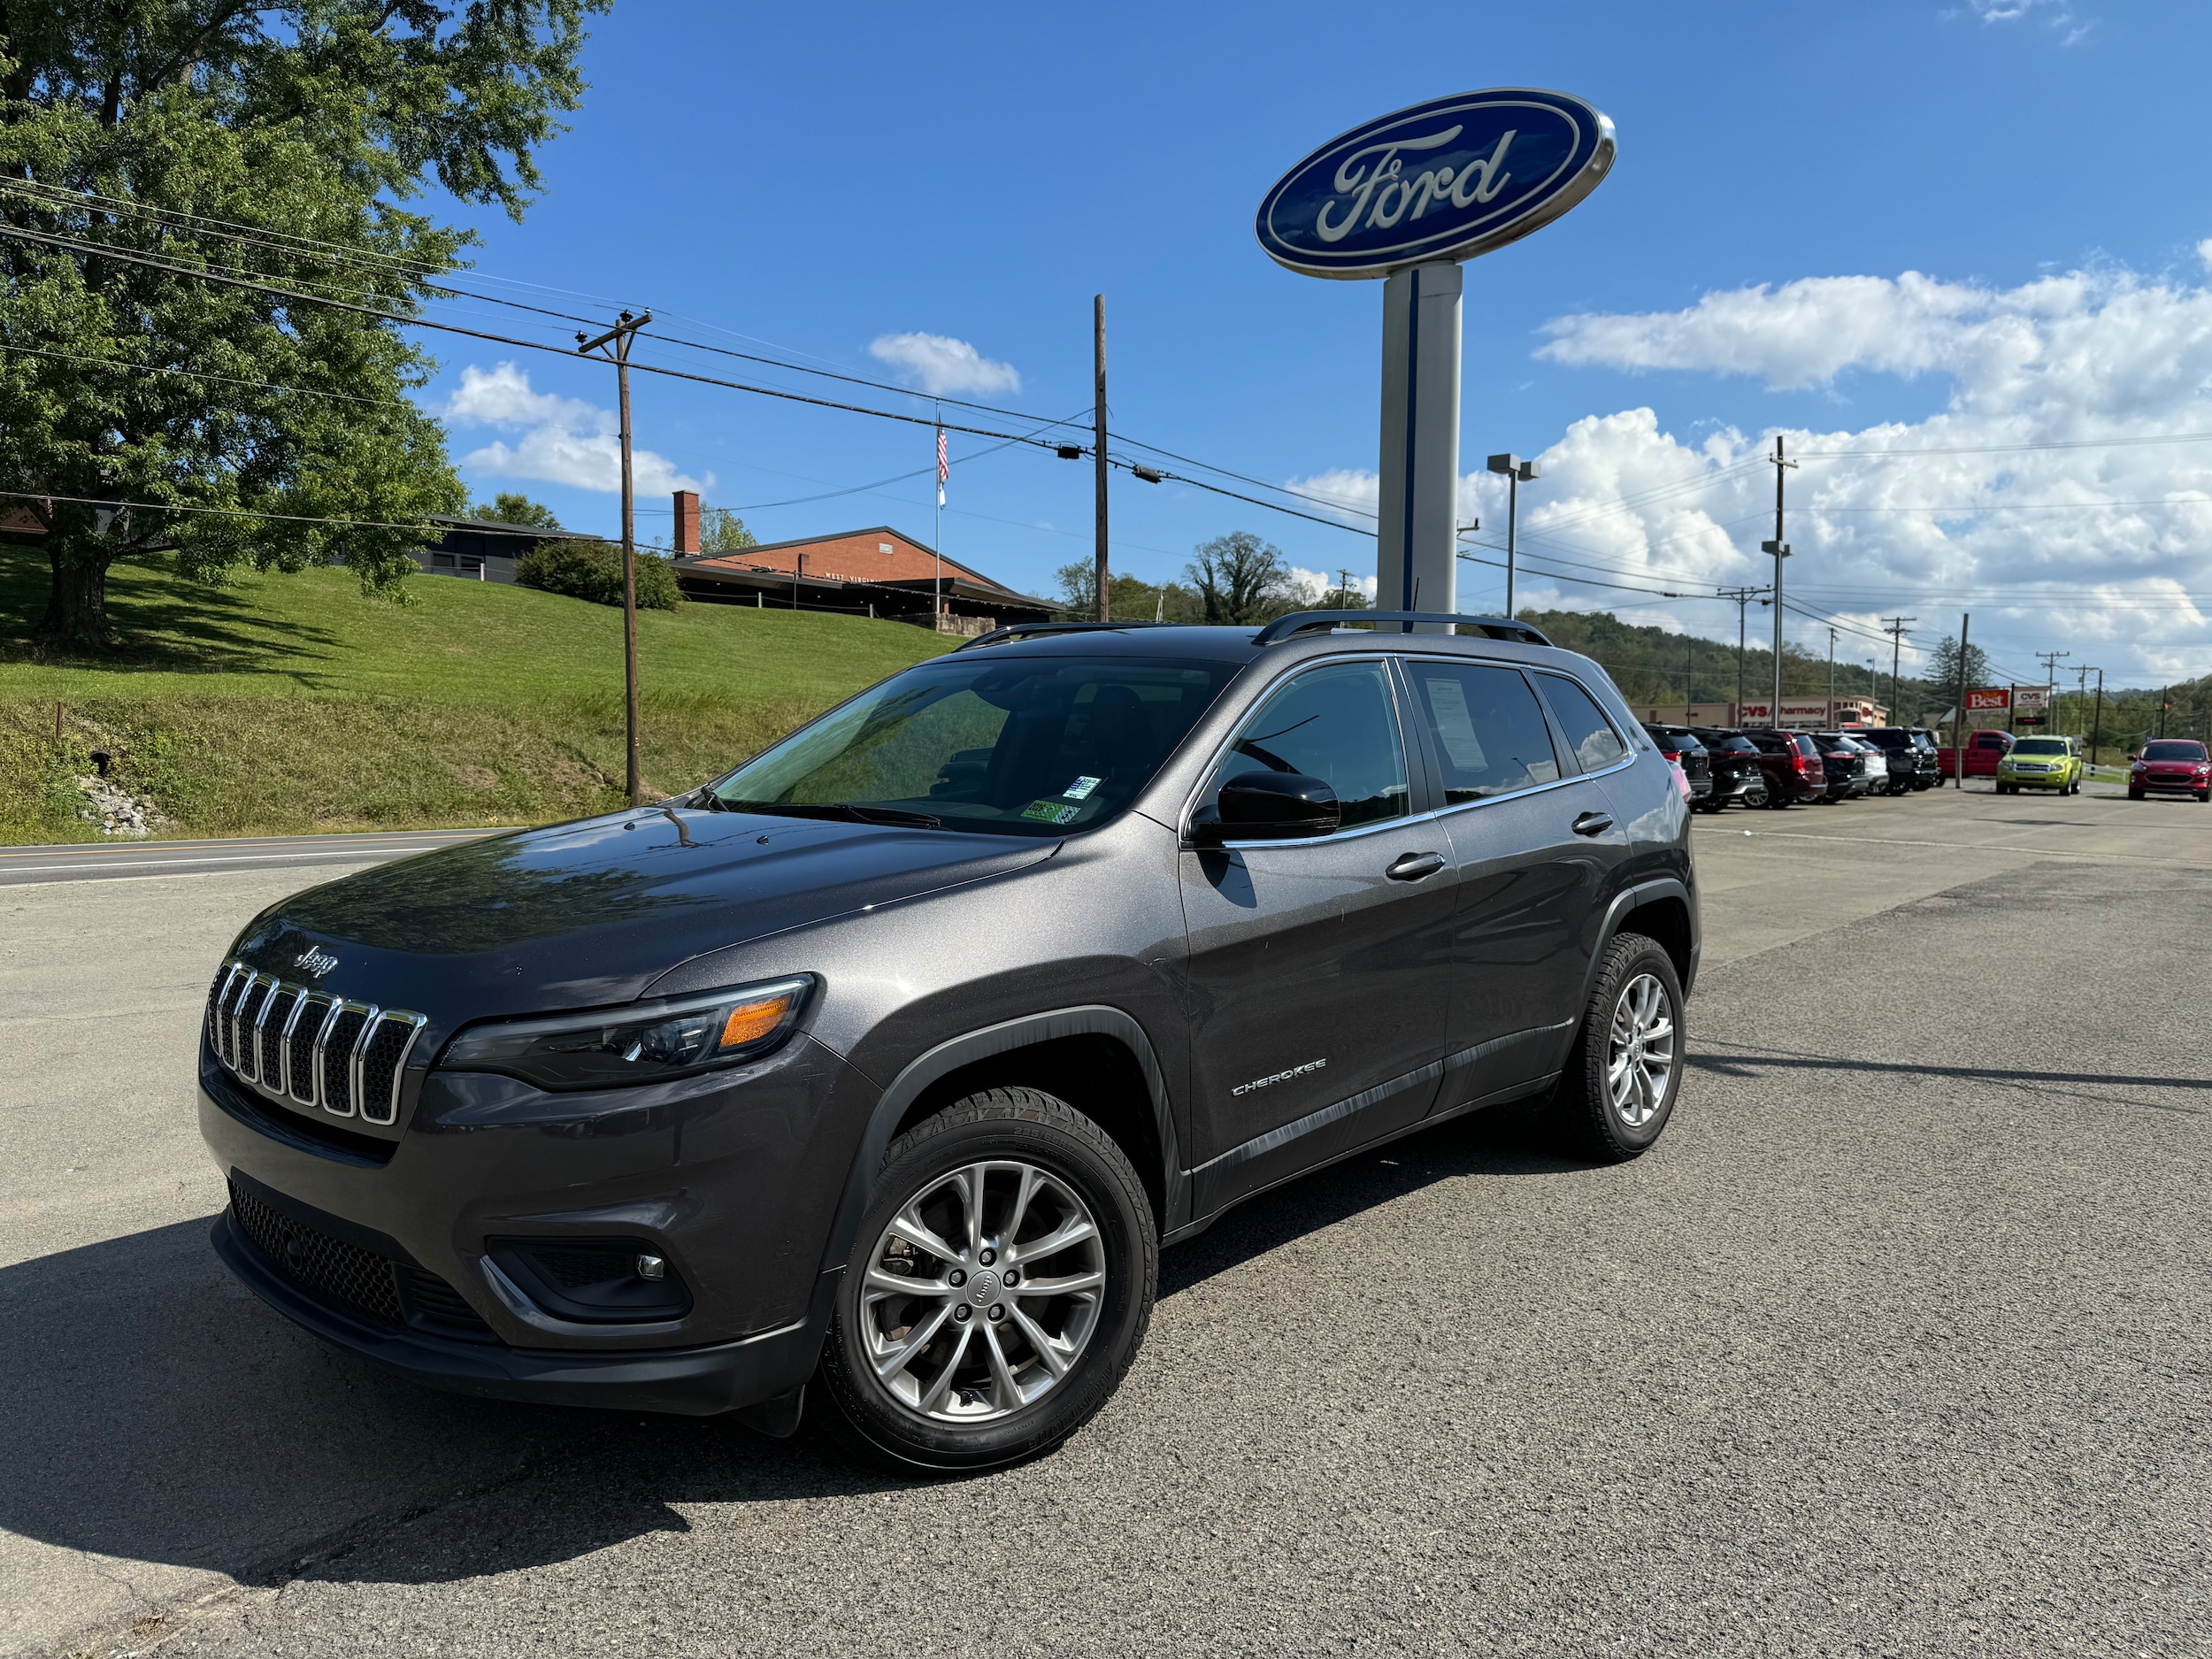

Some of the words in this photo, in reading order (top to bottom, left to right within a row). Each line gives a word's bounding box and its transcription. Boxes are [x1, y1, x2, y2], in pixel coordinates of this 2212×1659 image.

[1316, 124, 1517, 243] Ford
[825, 572, 844, 580] WEST
[1970, 694, 2004, 708] Best
[294, 945, 338, 979] Jeep
[1233, 1058, 1326, 1096] CHEROKEE
